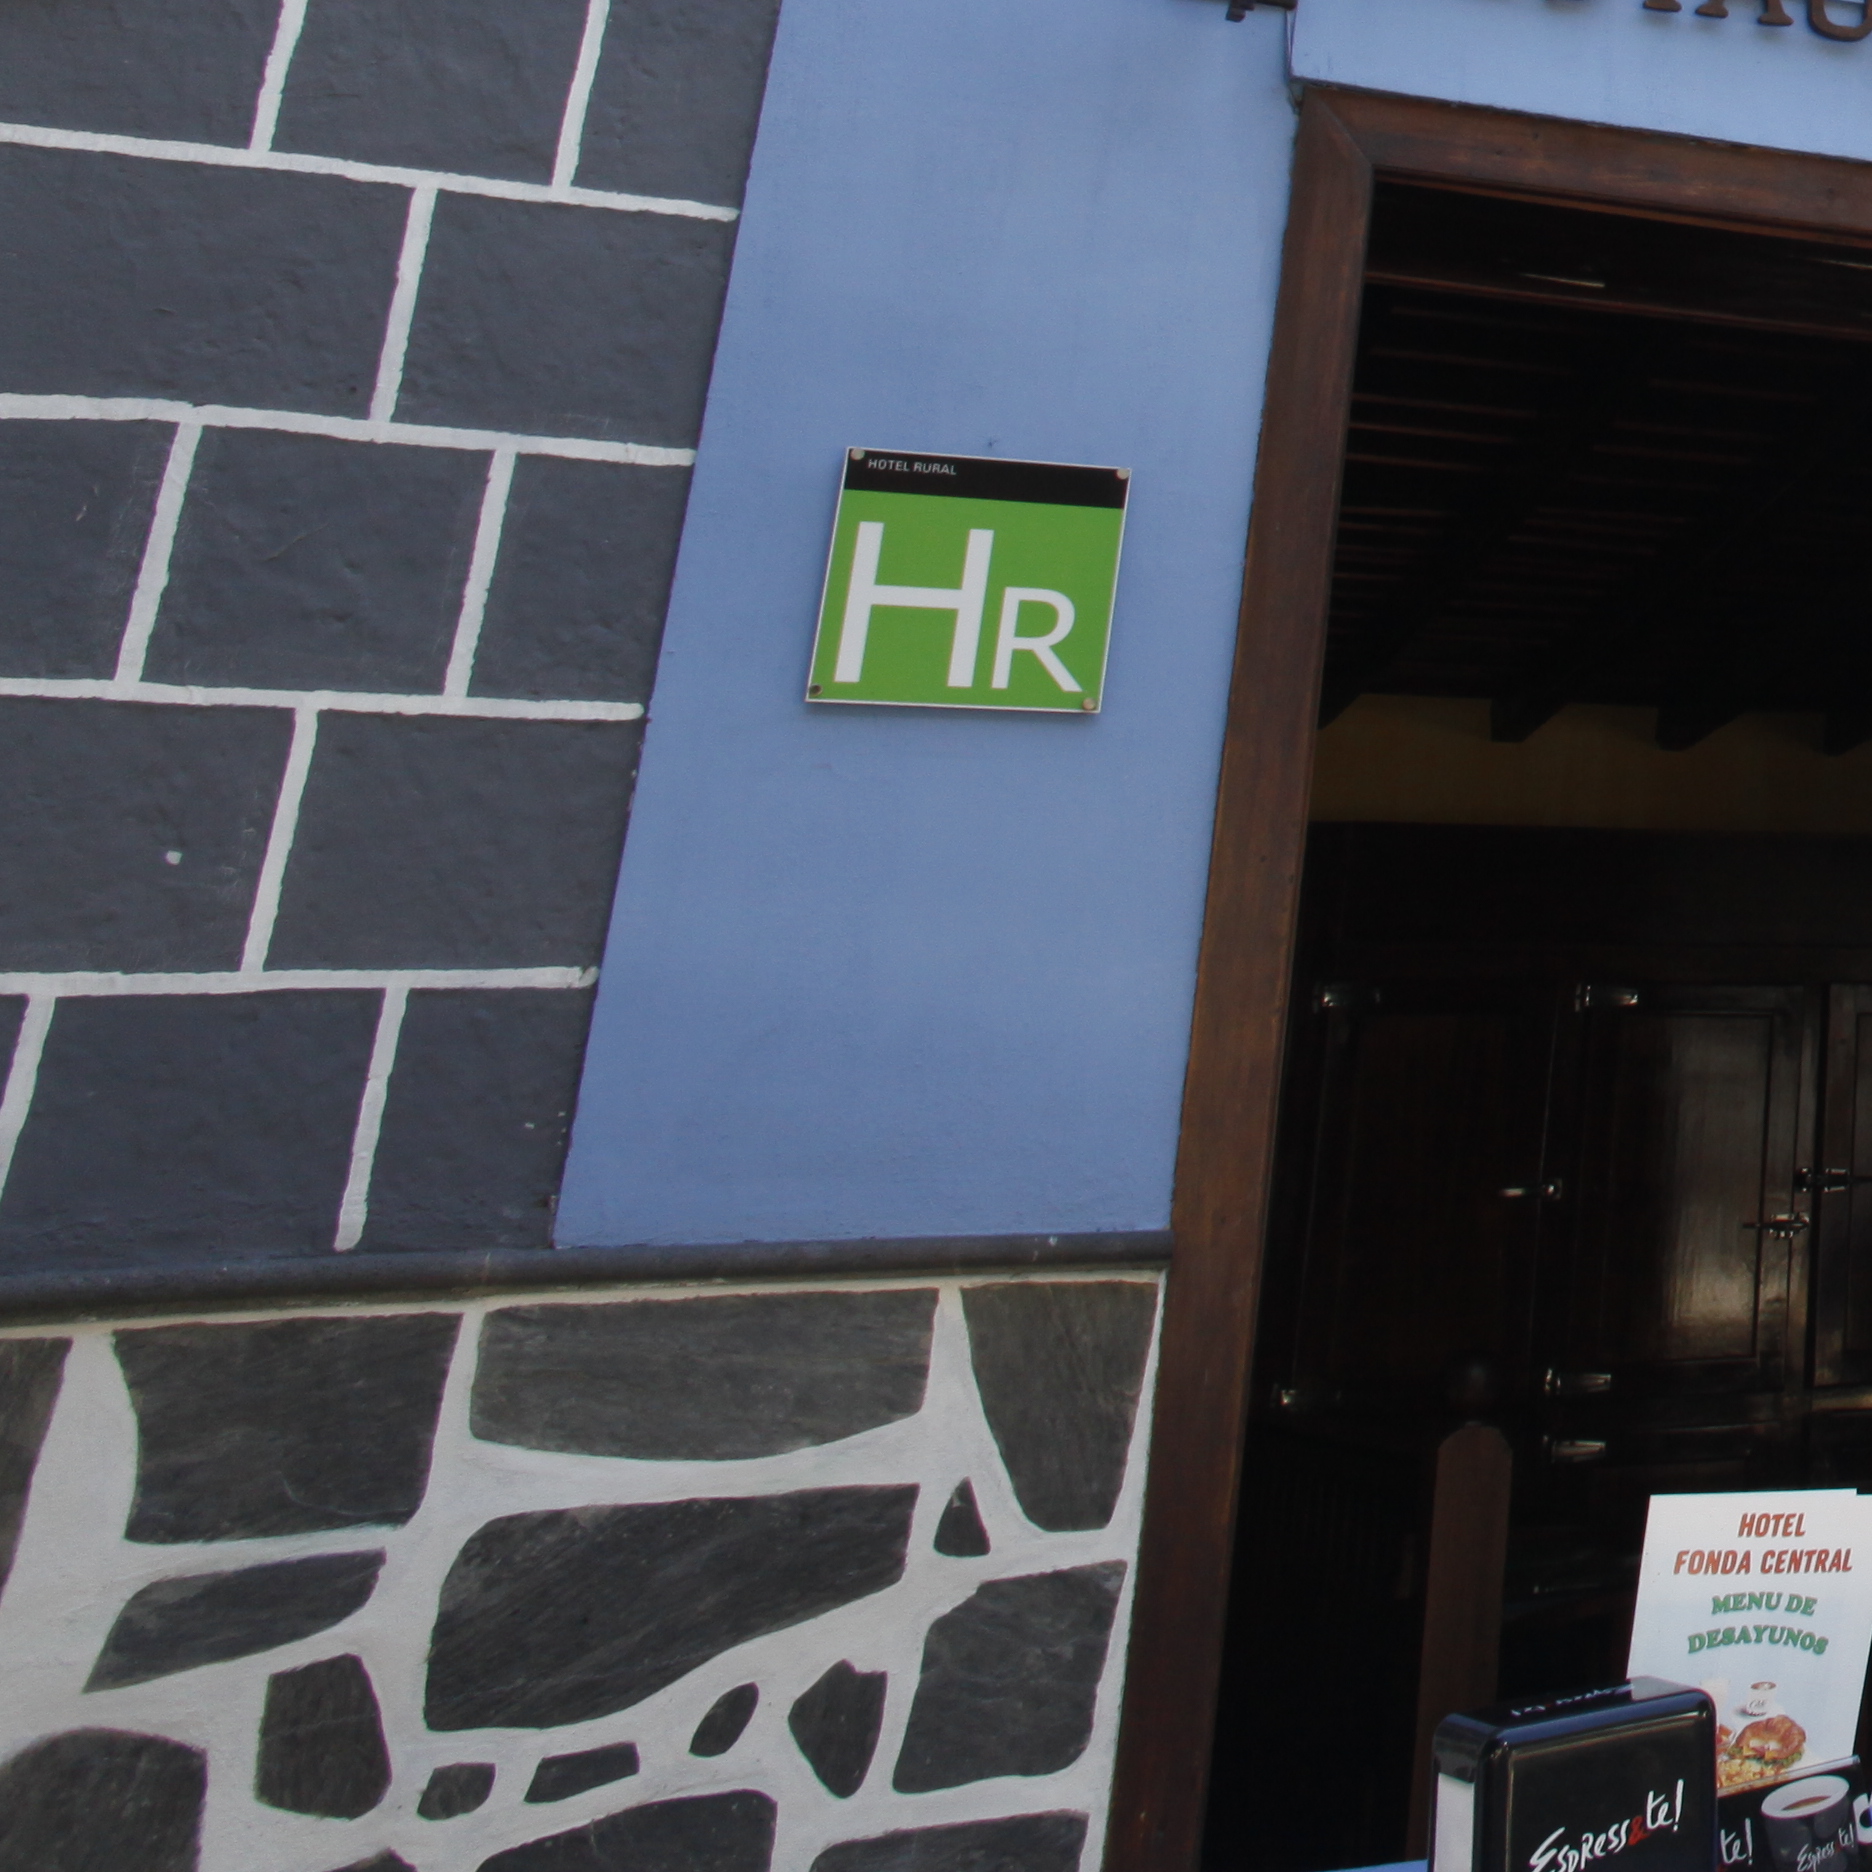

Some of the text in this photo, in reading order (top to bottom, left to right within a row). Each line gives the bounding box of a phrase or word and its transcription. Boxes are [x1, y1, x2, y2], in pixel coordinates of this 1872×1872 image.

[868, 458, 957, 475] HOTEL RURAL
[834, 521, 1083, 693] HR
[1738, 1512, 1806, 1538] HOTEL
[1674, 1548, 1853, 1575] FONDA CENTRAL
[1711, 1592, 1818, 1617] MENU DE
[1687, 1624, 1829, 1655] DESAYUNOS
